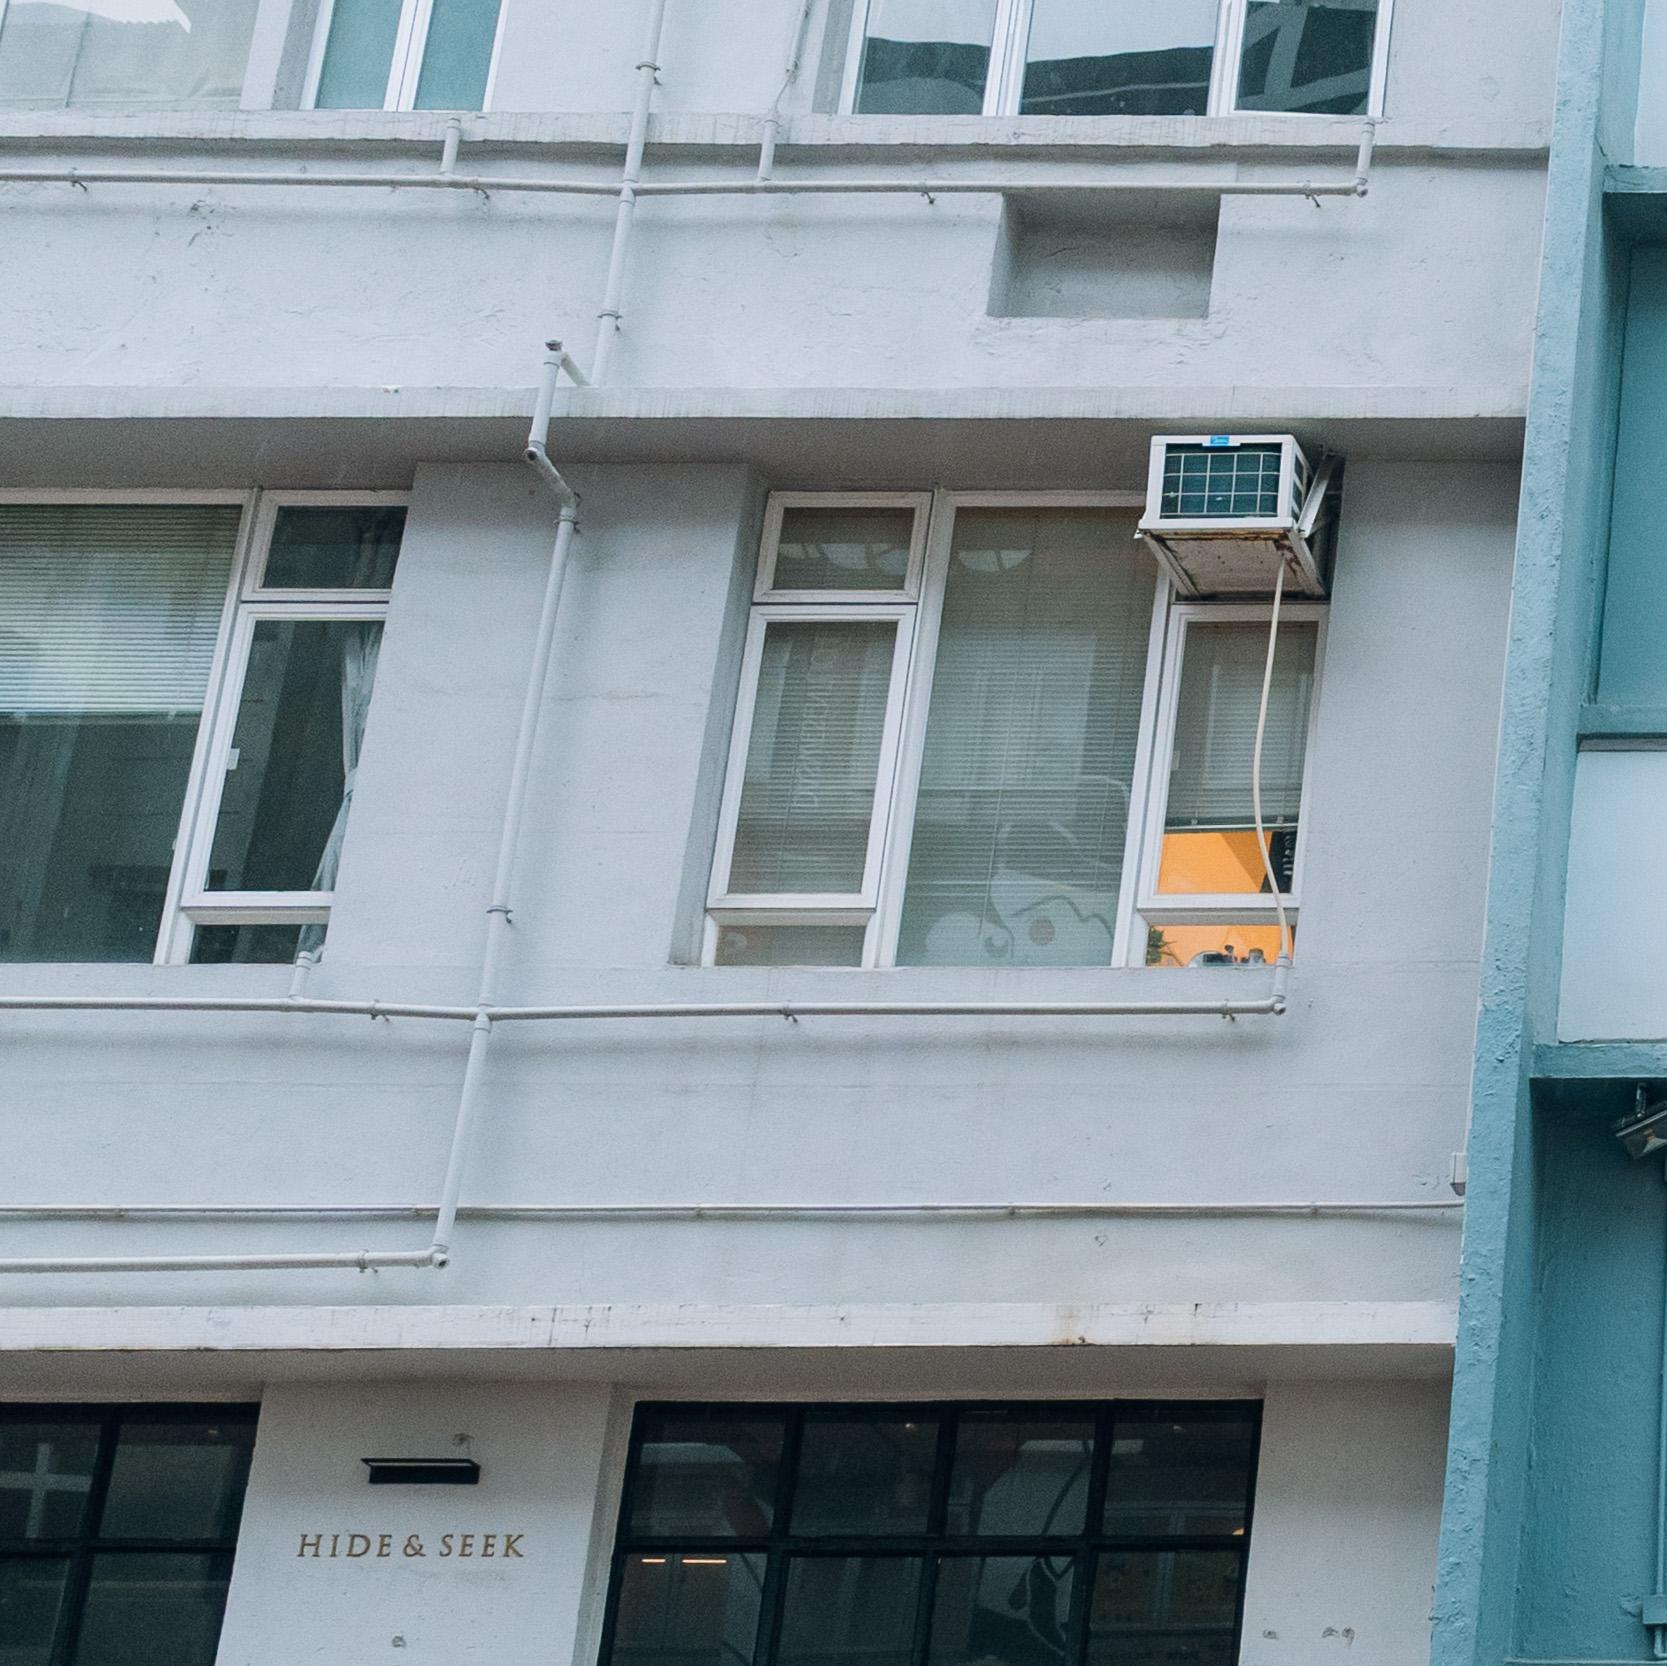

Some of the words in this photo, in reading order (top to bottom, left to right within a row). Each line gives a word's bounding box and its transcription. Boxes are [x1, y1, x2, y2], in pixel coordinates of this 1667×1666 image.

[296, 1534, 394, 1558] HIDE
[403, 1534, 427, 1558] &
[438, 1533, 526, 1558] SEEK
